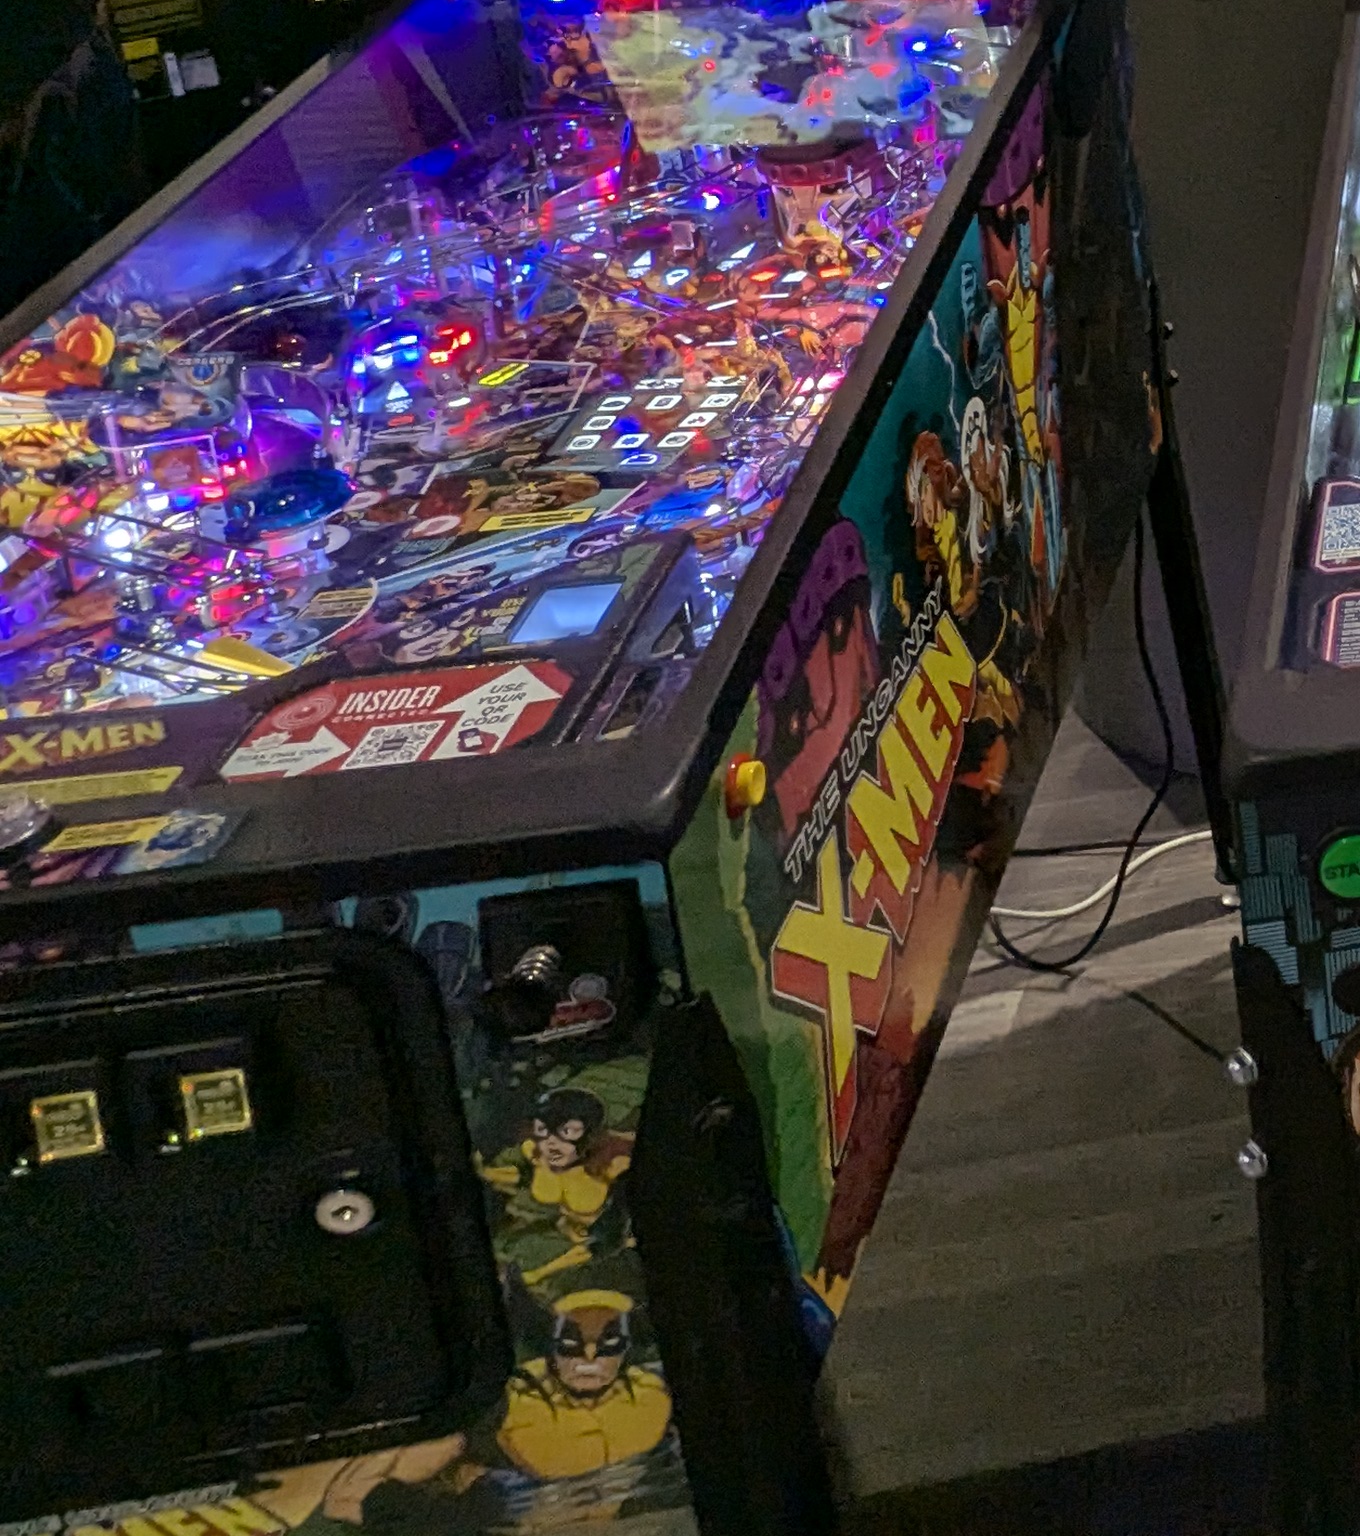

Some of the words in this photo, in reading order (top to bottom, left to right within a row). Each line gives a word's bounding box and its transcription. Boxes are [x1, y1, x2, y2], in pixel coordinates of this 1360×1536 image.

[490, 681, 528, 694] USE
[338, 685, 442, 715] INSIDER
[477, 692, 528, 705] YOUR
[460, 714, 515, 727] CODE
[482, 704, 508, 716] QR
[784, 752, 843, 886] THE
[841, 574, 946, 792] UNCANNY
[0, 720, 166, 772] X-MEN
[770, 606, 980, 1170] X-MEN
